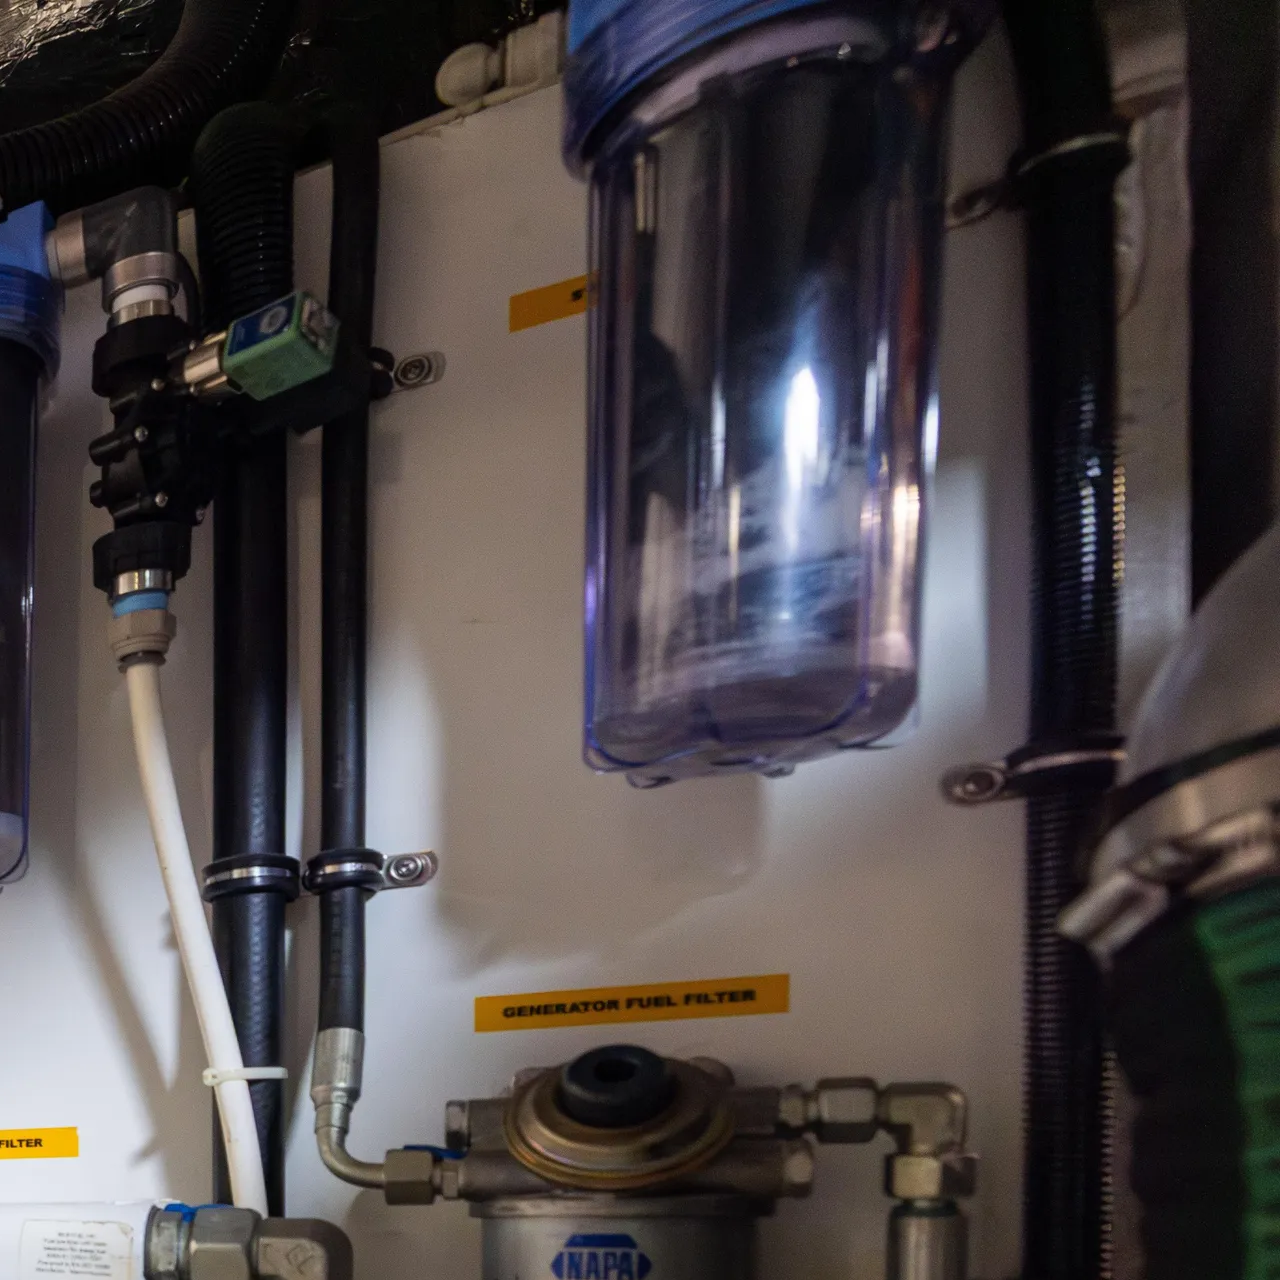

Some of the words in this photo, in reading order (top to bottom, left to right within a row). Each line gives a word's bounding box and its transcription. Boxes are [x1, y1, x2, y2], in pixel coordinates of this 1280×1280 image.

[502, 998, 620, 1018] GENERATOR
[626, 995, 677, 1010] FUEL
[683, 989, 757, 1006] FILTER
[565, 1252, 634, 1280] NAPA
